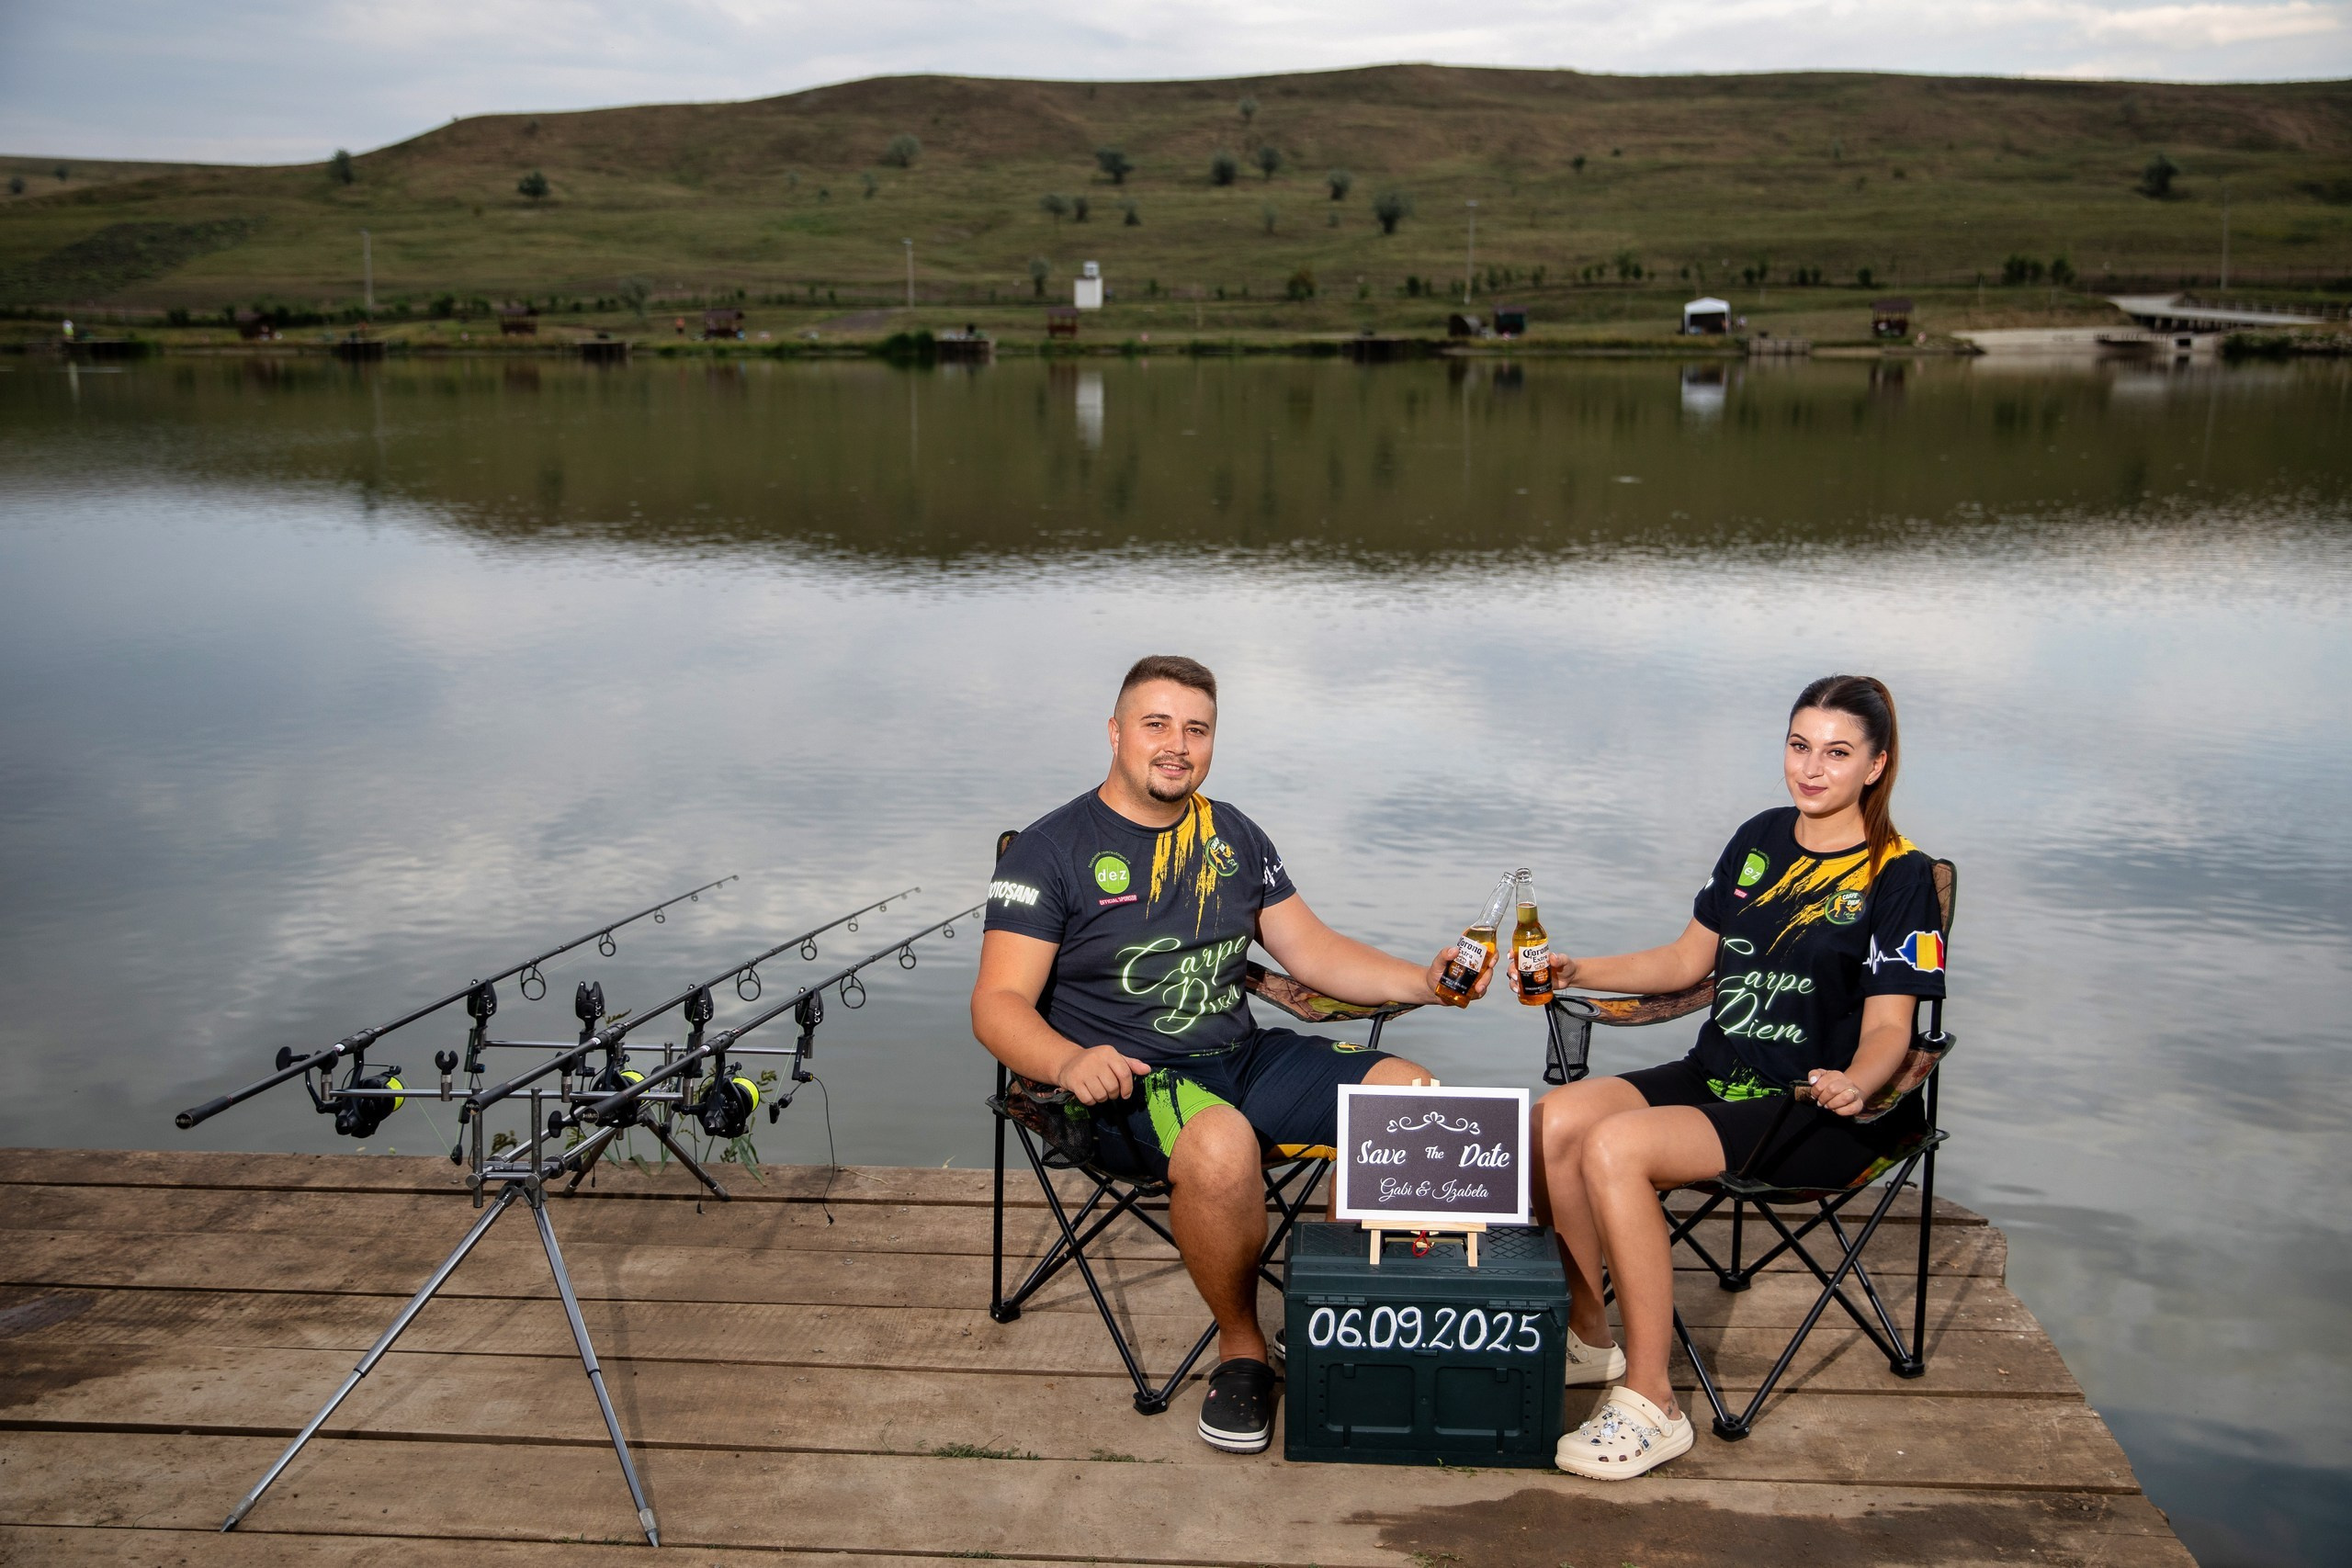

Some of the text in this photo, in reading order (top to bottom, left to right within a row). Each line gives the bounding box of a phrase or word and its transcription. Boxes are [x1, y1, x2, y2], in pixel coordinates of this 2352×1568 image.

[1098, 869, 1127, 882] dez
[988, 881, 1040, 907] OTOȘANI
[1115, 935, 1247, 995] Carpe
[1357, 1140, 1510, 1168] Save The Date
[1378, 1178, 1489, 1202] Gabi & Izabela
[1308, 1305, 1541, 1352] 06.09.2025
